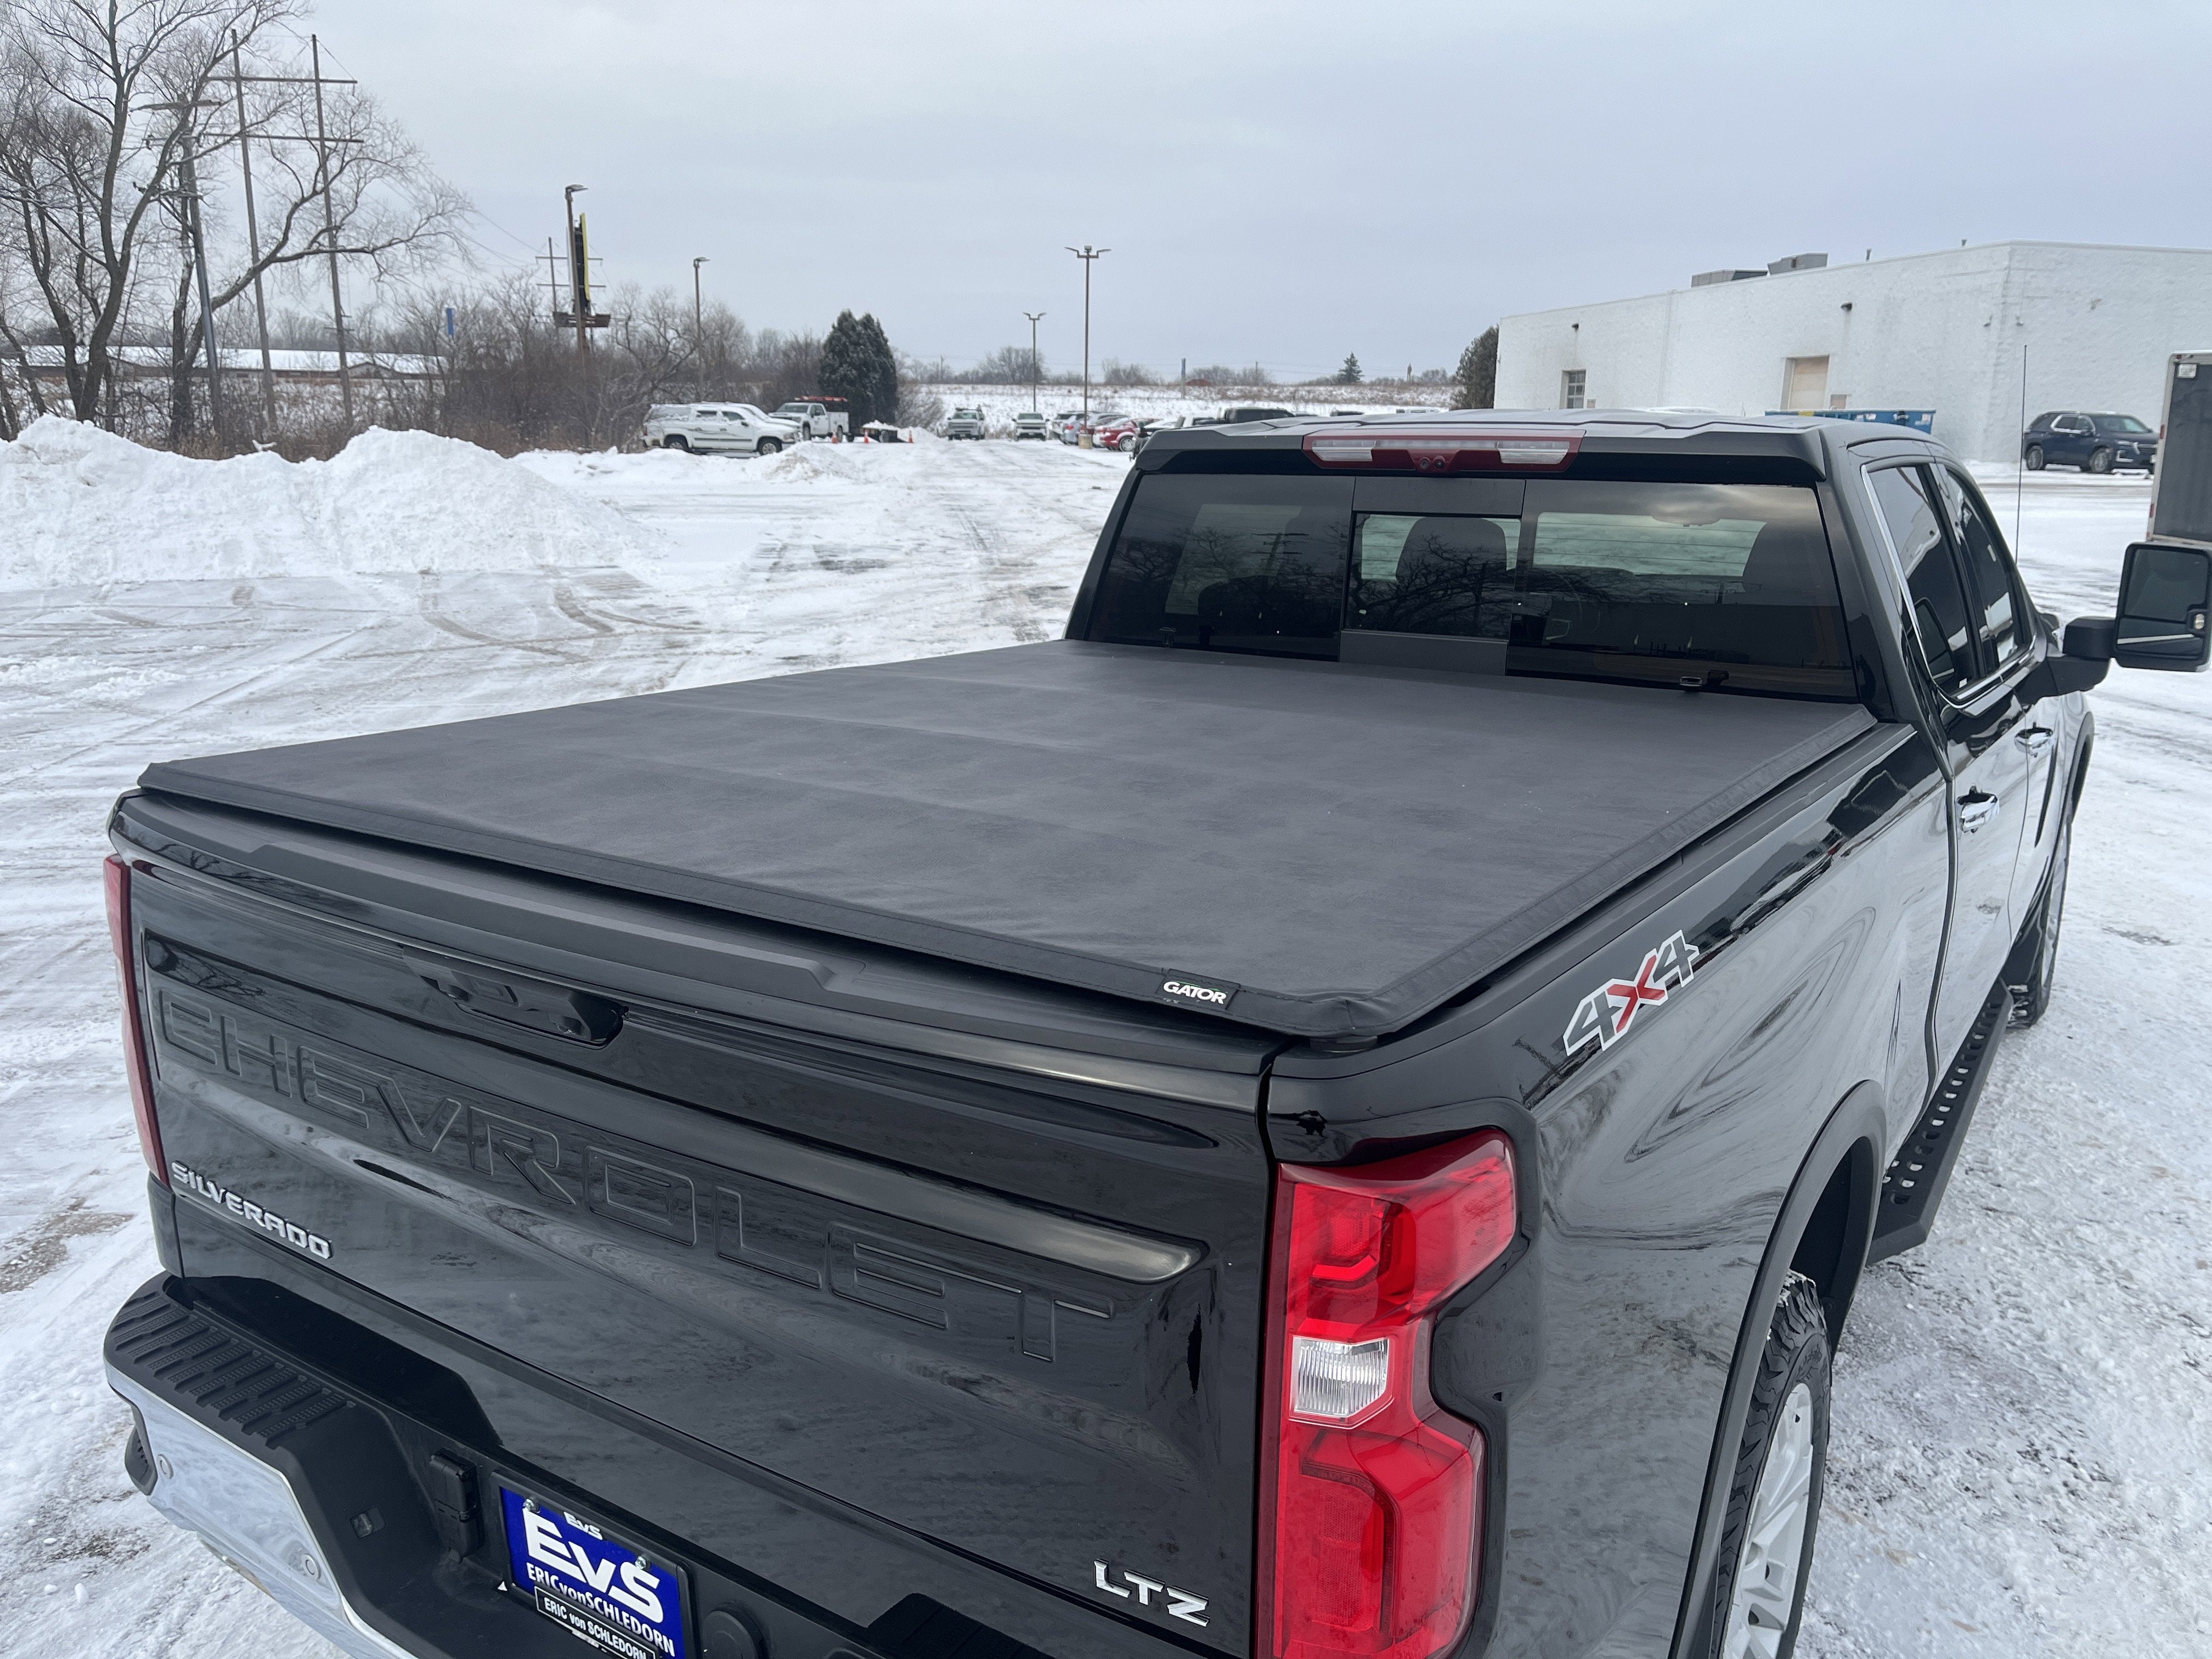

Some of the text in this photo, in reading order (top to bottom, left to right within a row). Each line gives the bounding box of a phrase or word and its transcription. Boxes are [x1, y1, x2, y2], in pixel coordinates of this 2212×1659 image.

[1163, 981, 1227, 1005] GATOR
[171, 1160, 331, 1260] SILVERADO
[1094, 1559, 1210, 1627] LTZ
[544, 1597, 647, 1659] ERIC von SCHLEDORN
